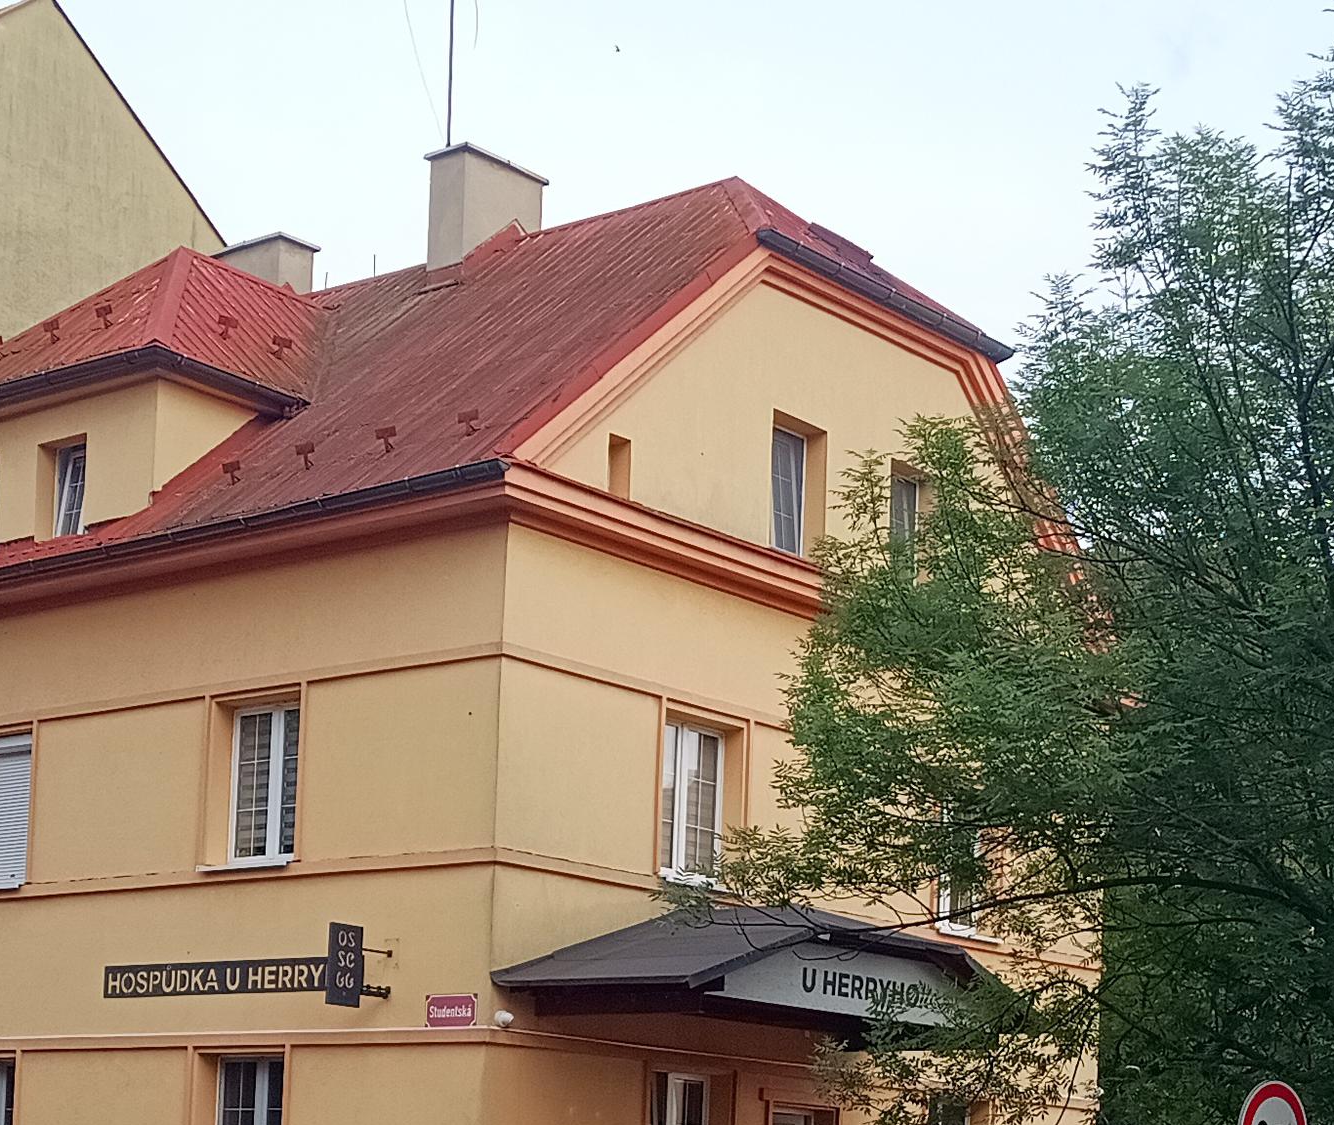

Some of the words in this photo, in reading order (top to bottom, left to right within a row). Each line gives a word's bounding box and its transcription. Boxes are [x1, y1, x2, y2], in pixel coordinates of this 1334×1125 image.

[107, 965, 218, 995] HOSPŮDKA
[225, 967, 240, 991] U
[247, 964, 325, 990] HERRY
[802, 967, 817, 993] U
[429, 1003, 472, 1018] Studentská
